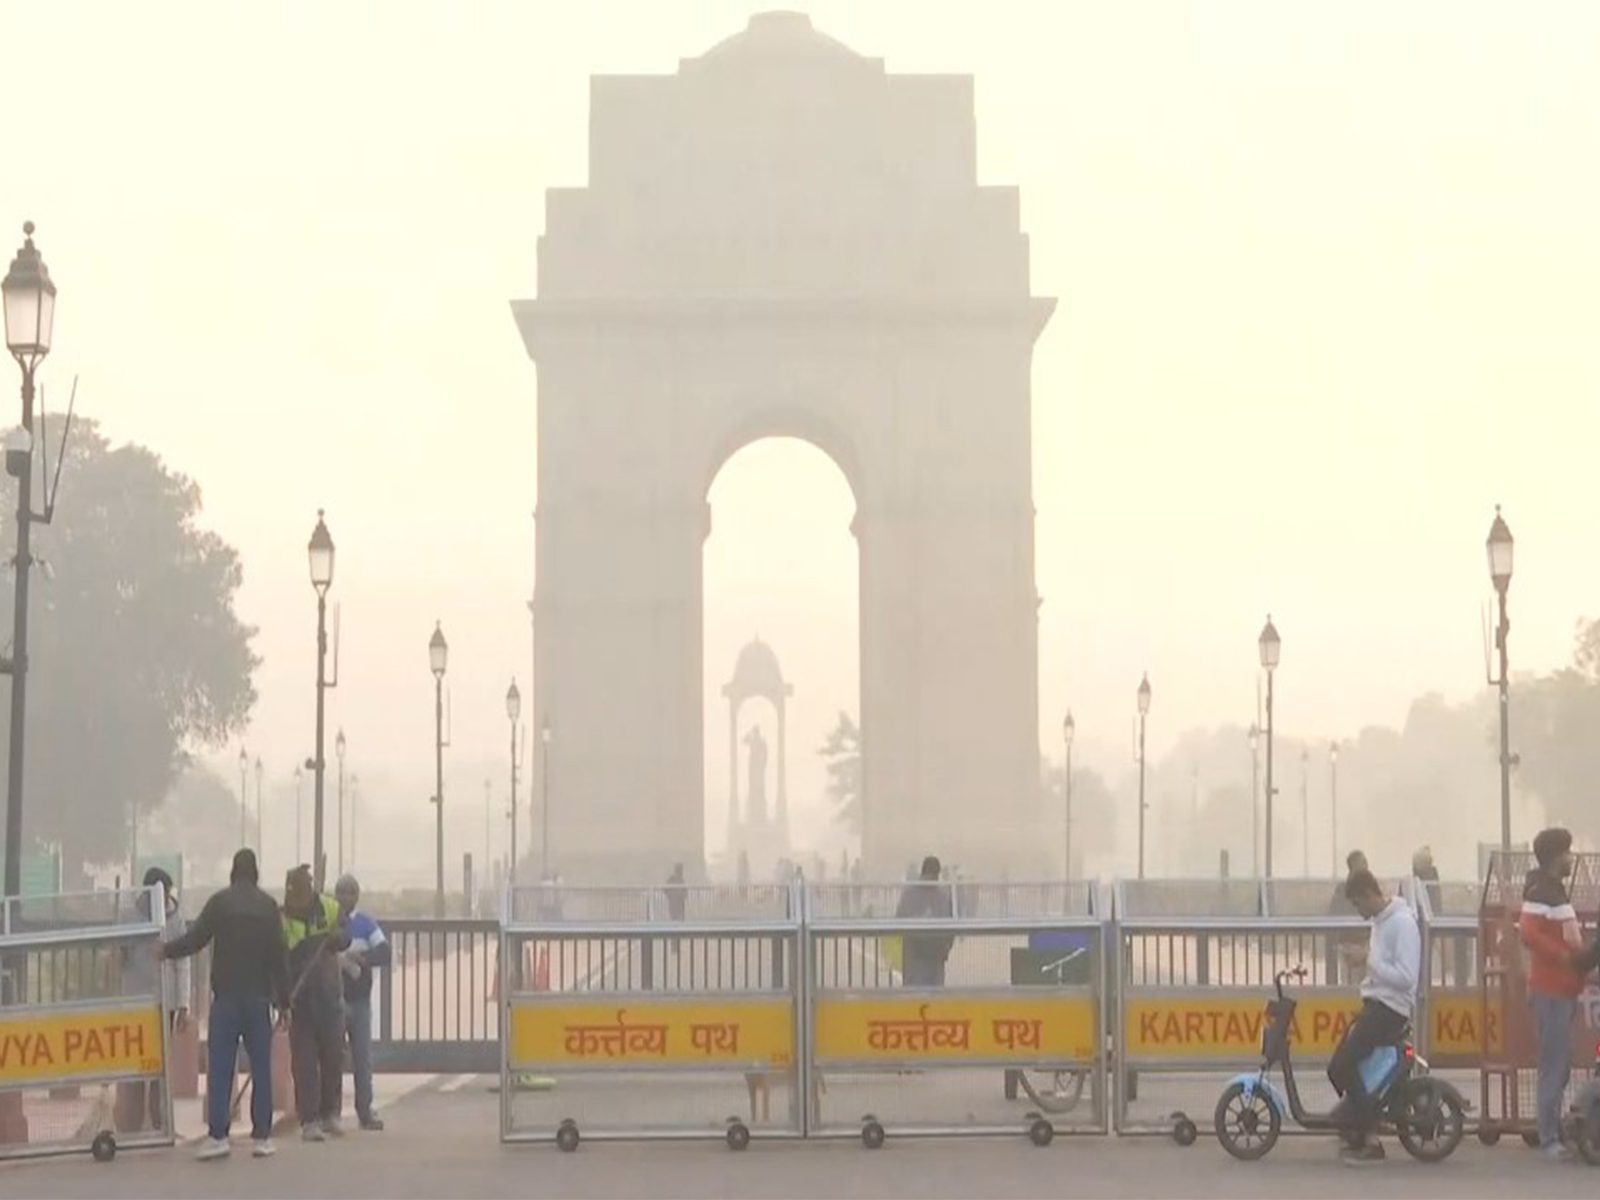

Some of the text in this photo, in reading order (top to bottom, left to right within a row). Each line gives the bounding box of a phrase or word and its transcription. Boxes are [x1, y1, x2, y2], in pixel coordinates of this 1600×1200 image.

[64, 1024, 145, 1063] PATH
[690, 1022, 739, 1054] पथ
[991, 1019, 1042, 1050] पथ
[1140, 1010, 1302, 1044] KARTAVA
